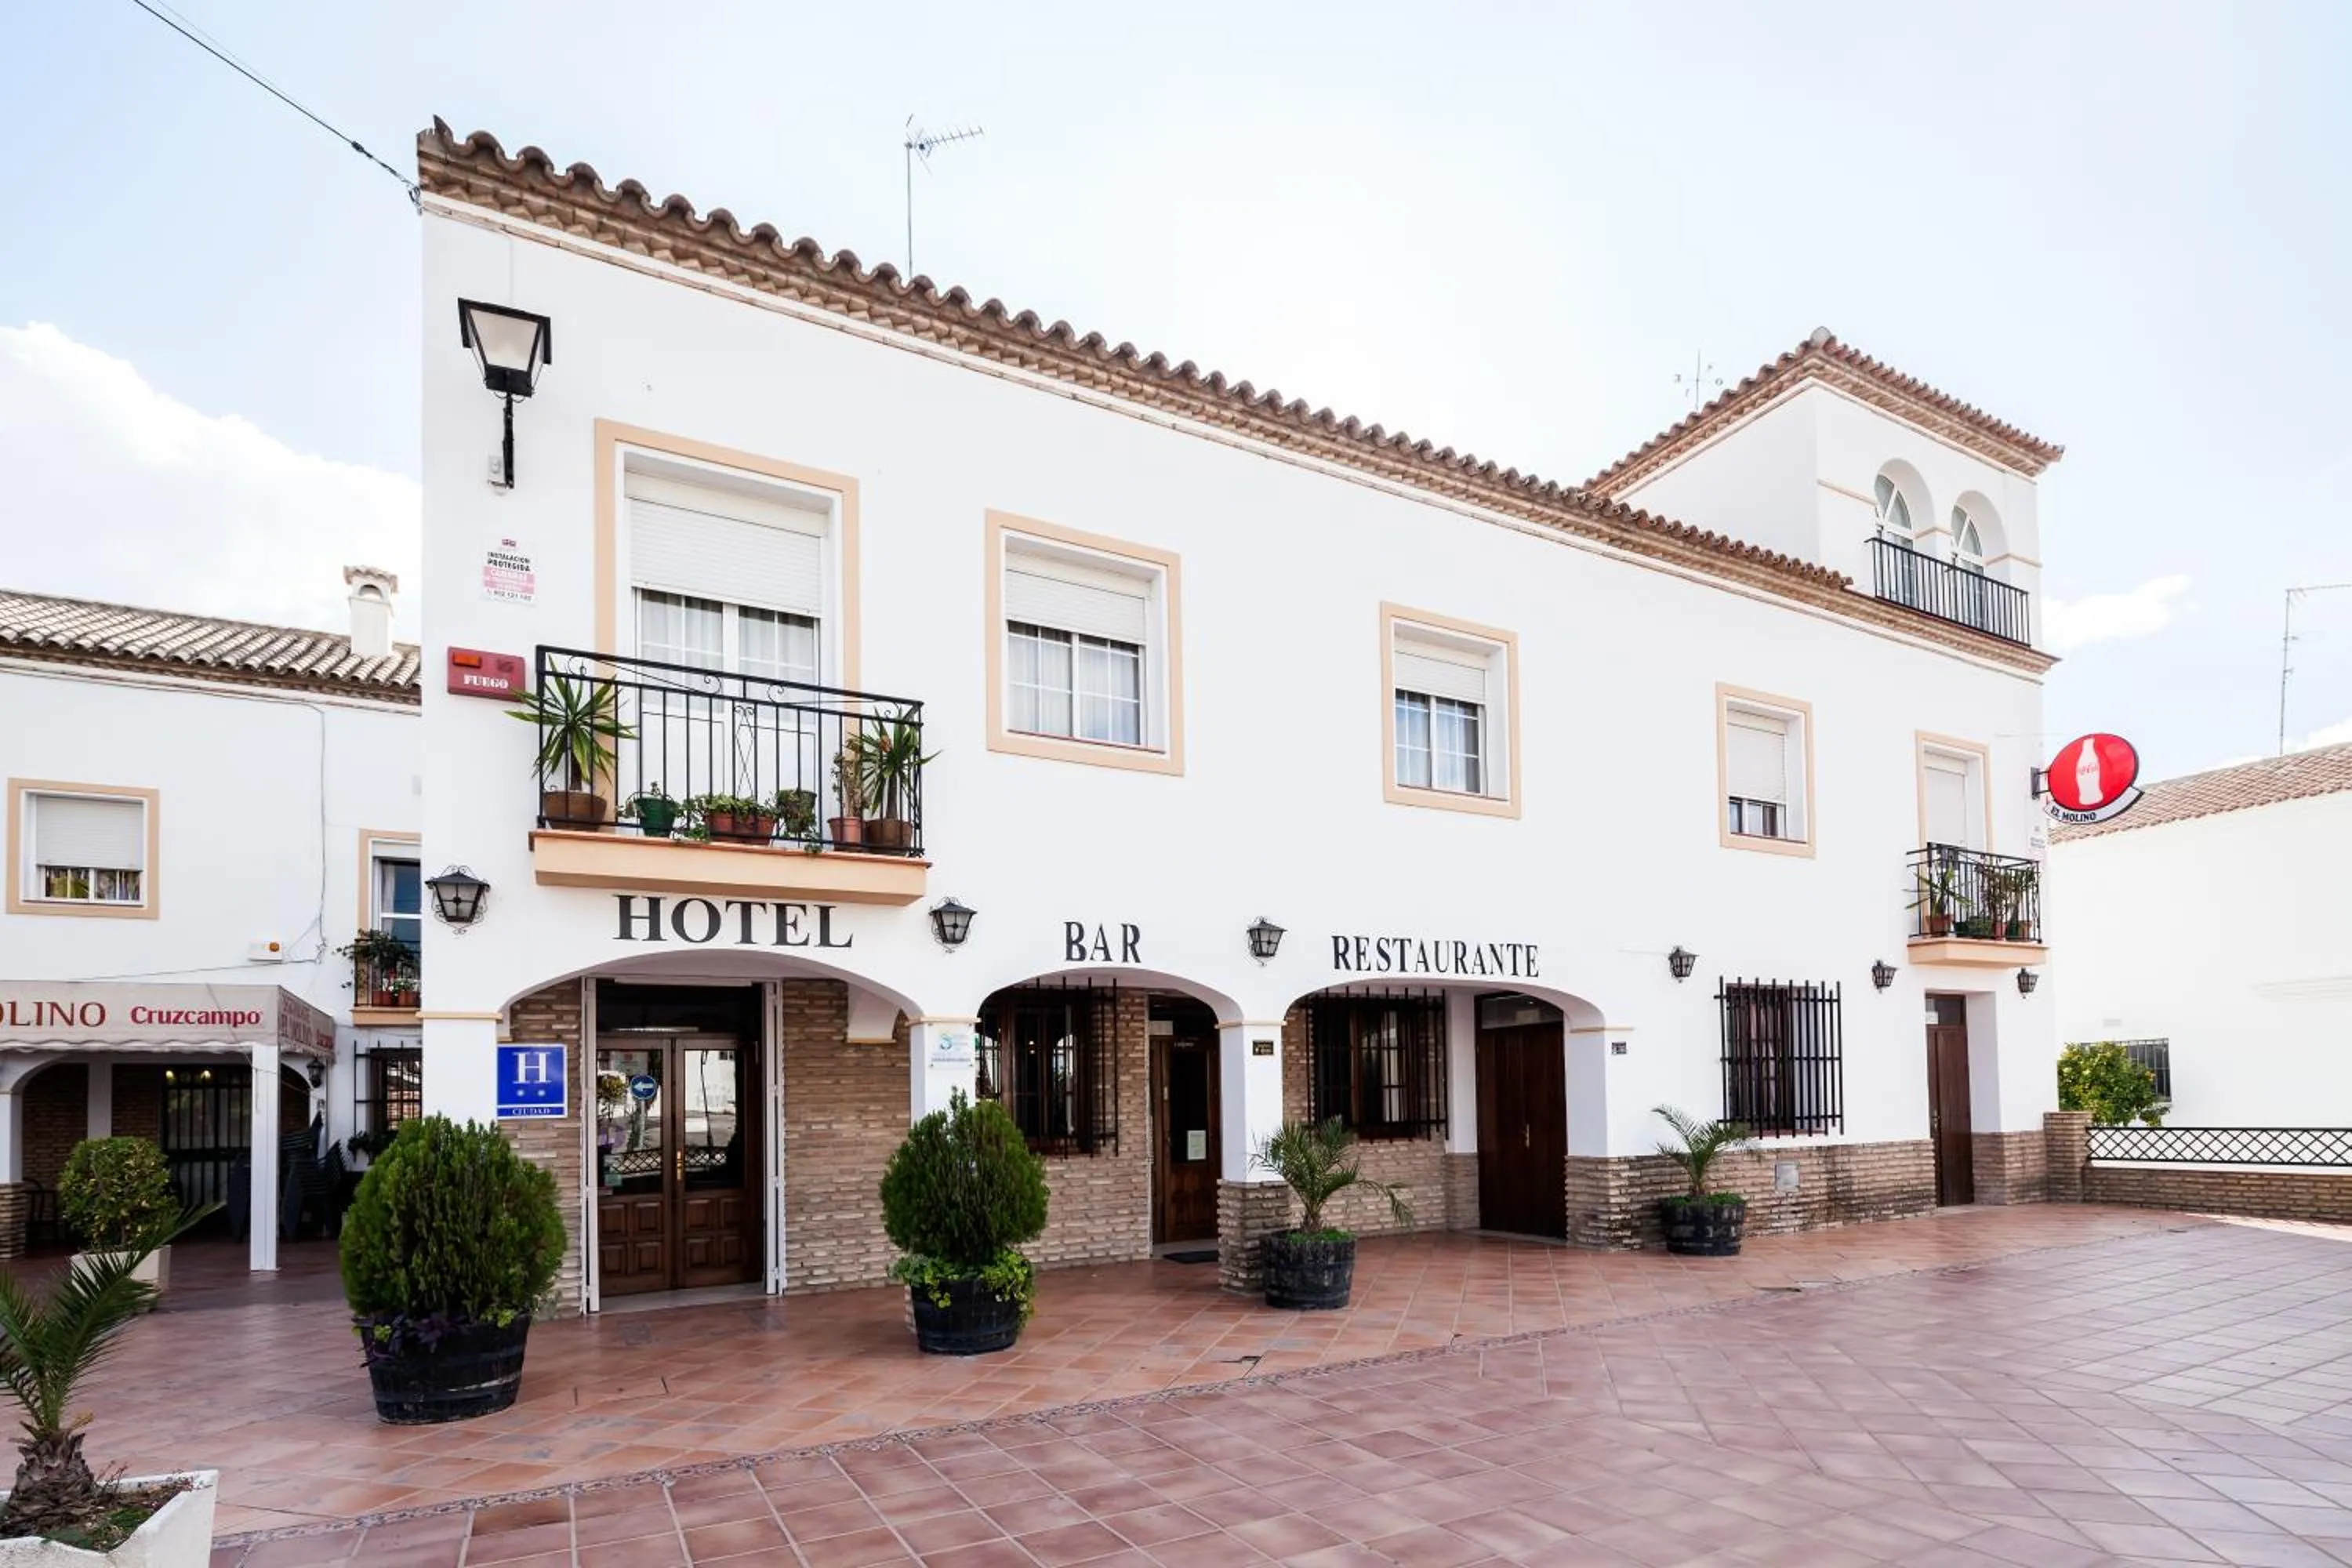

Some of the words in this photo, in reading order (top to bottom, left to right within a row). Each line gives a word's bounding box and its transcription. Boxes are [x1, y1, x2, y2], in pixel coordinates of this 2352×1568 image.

[487, 557, 531, 572] PROTEGIDA
[463, 674, 509, 689] FUEGO
[2050, 805, 2060, 817] EL
[2062, 811, 2097, 823] MOLINO
[612, 894, 854, 948] HOTEL
[1064, 921, 1142, 963] BAR
[1331, 935, 1540, 978] RESTAURANTE
[0, 1000, 106, 1027] LINO
[130, 1006, 261, 1028] Cruzcampo
[512, 1051, 552, 1083] H
